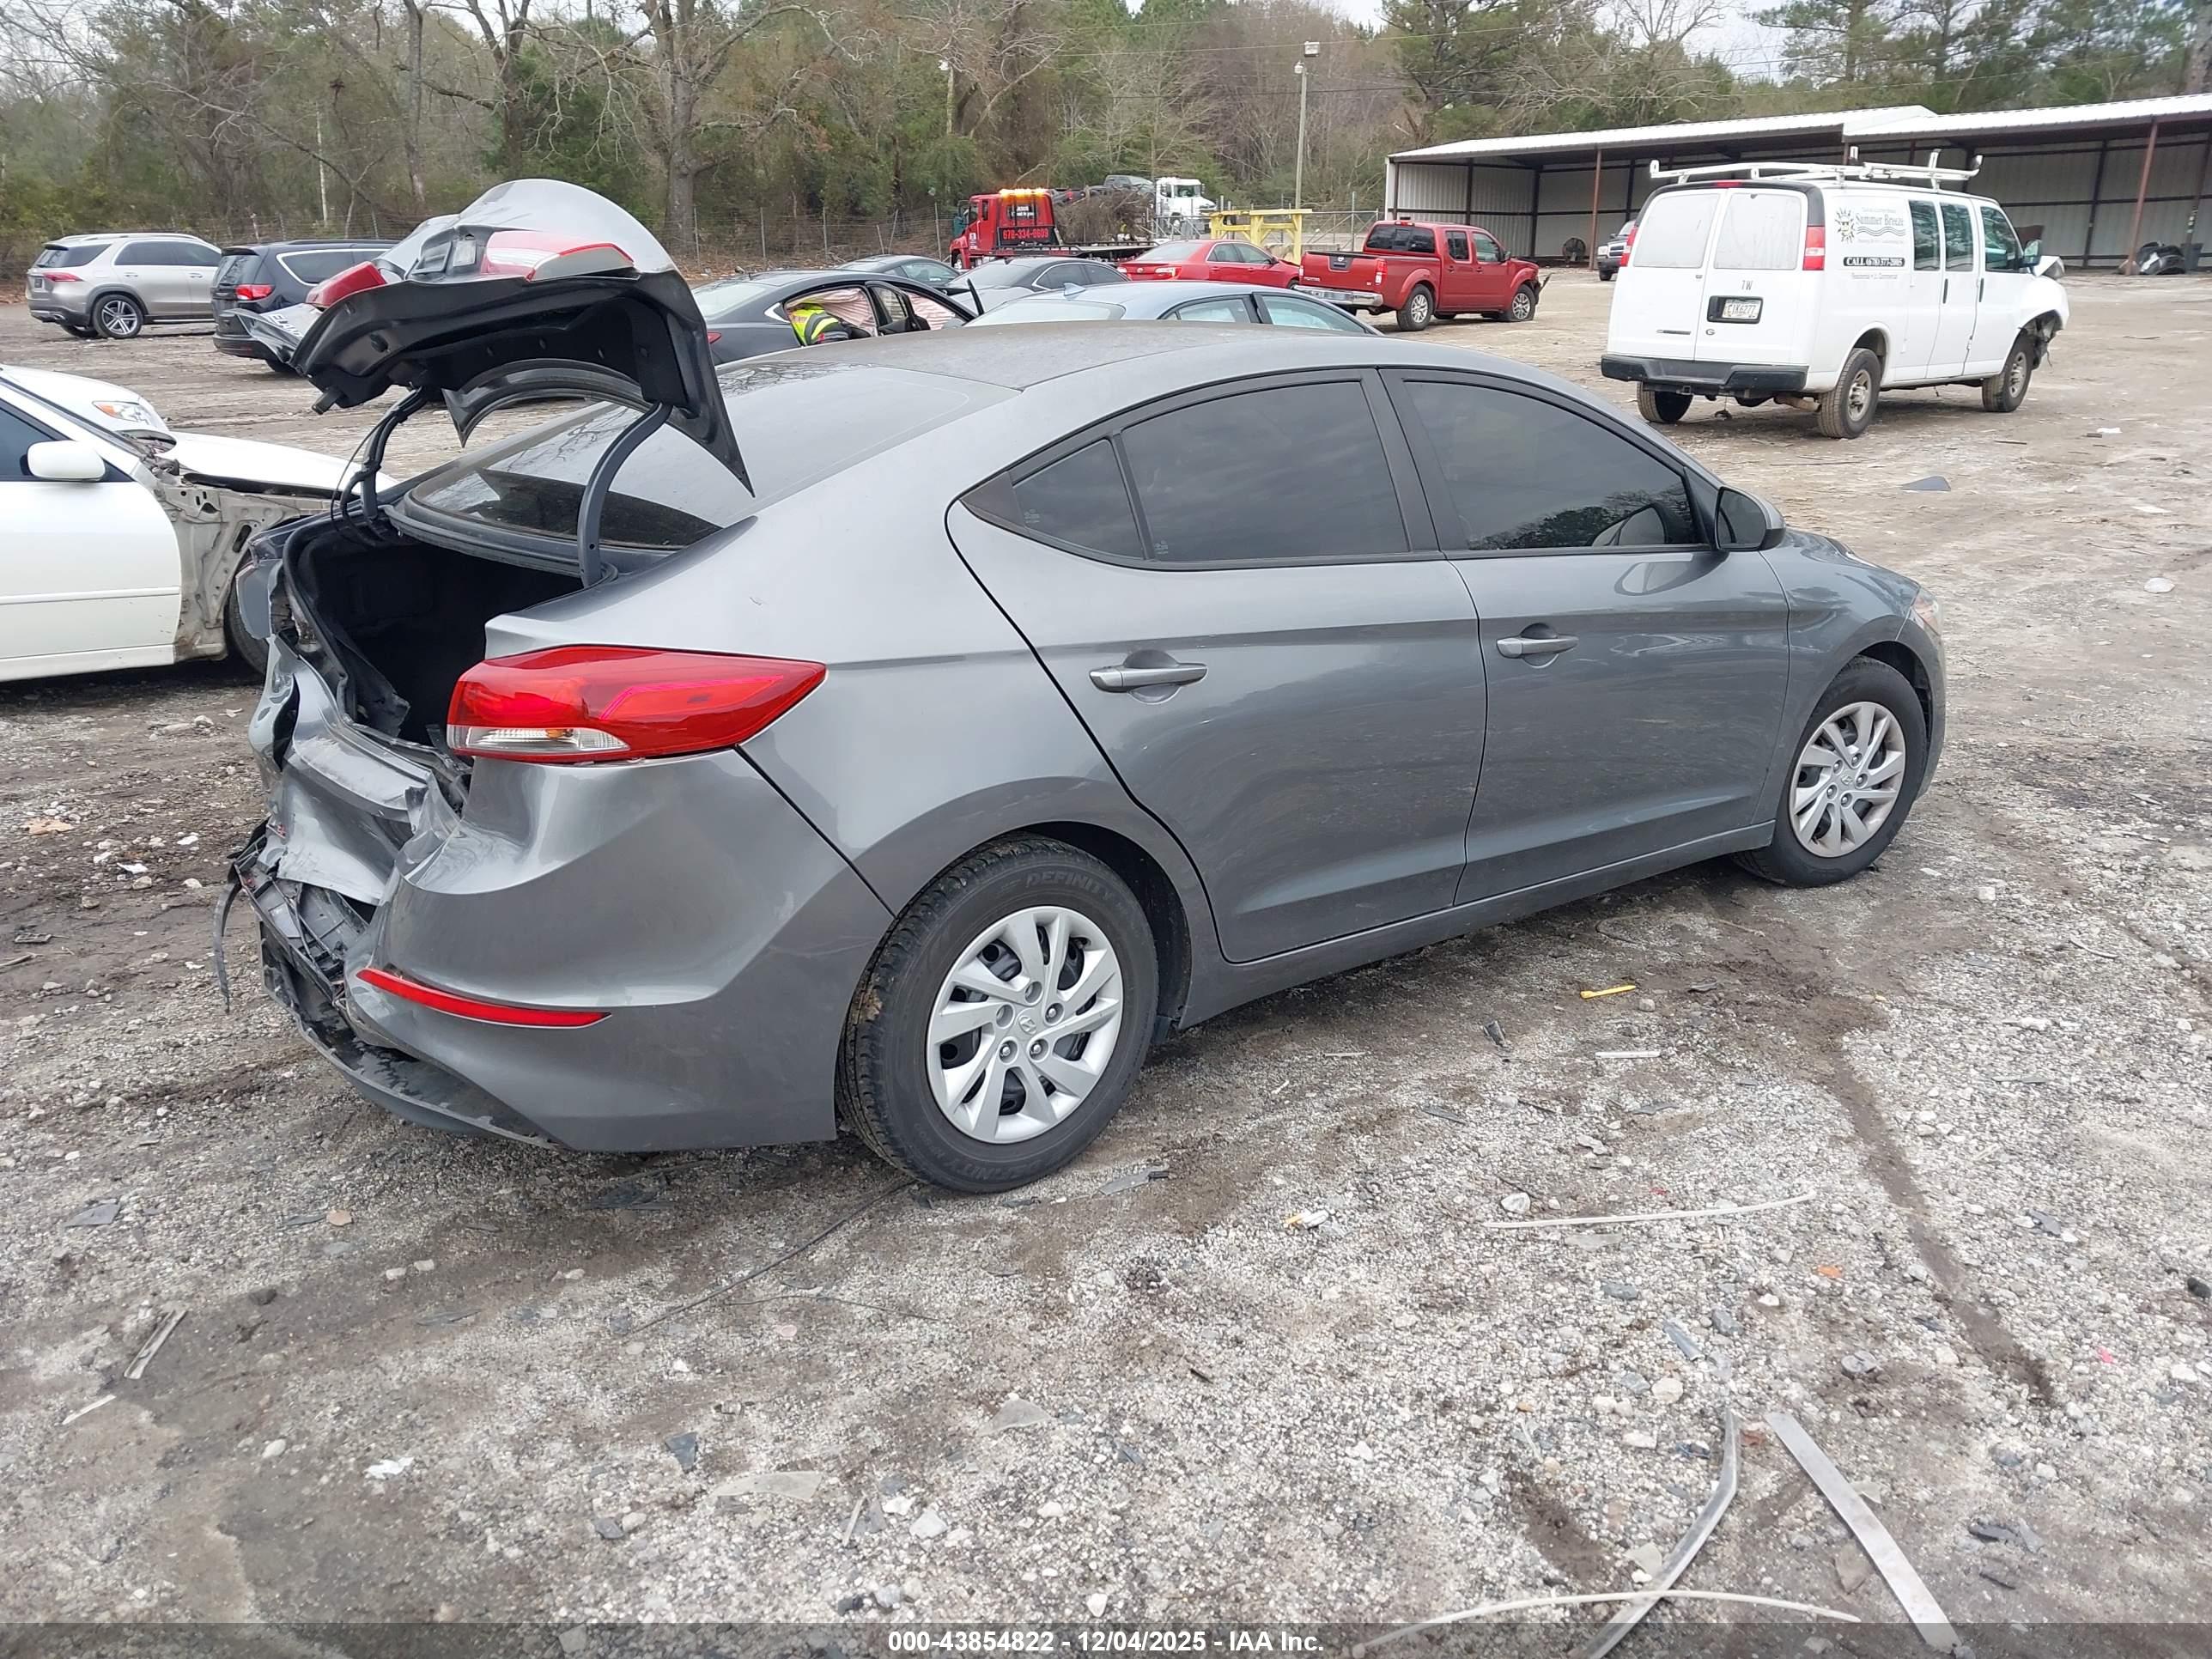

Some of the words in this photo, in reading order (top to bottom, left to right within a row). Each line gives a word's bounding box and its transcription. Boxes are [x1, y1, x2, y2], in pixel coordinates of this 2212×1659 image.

[1856, 213, 1882, 225] Summer
[1884, 214, 1904, 226] Breeze
[1846, 257, 1866, 266] CALL
